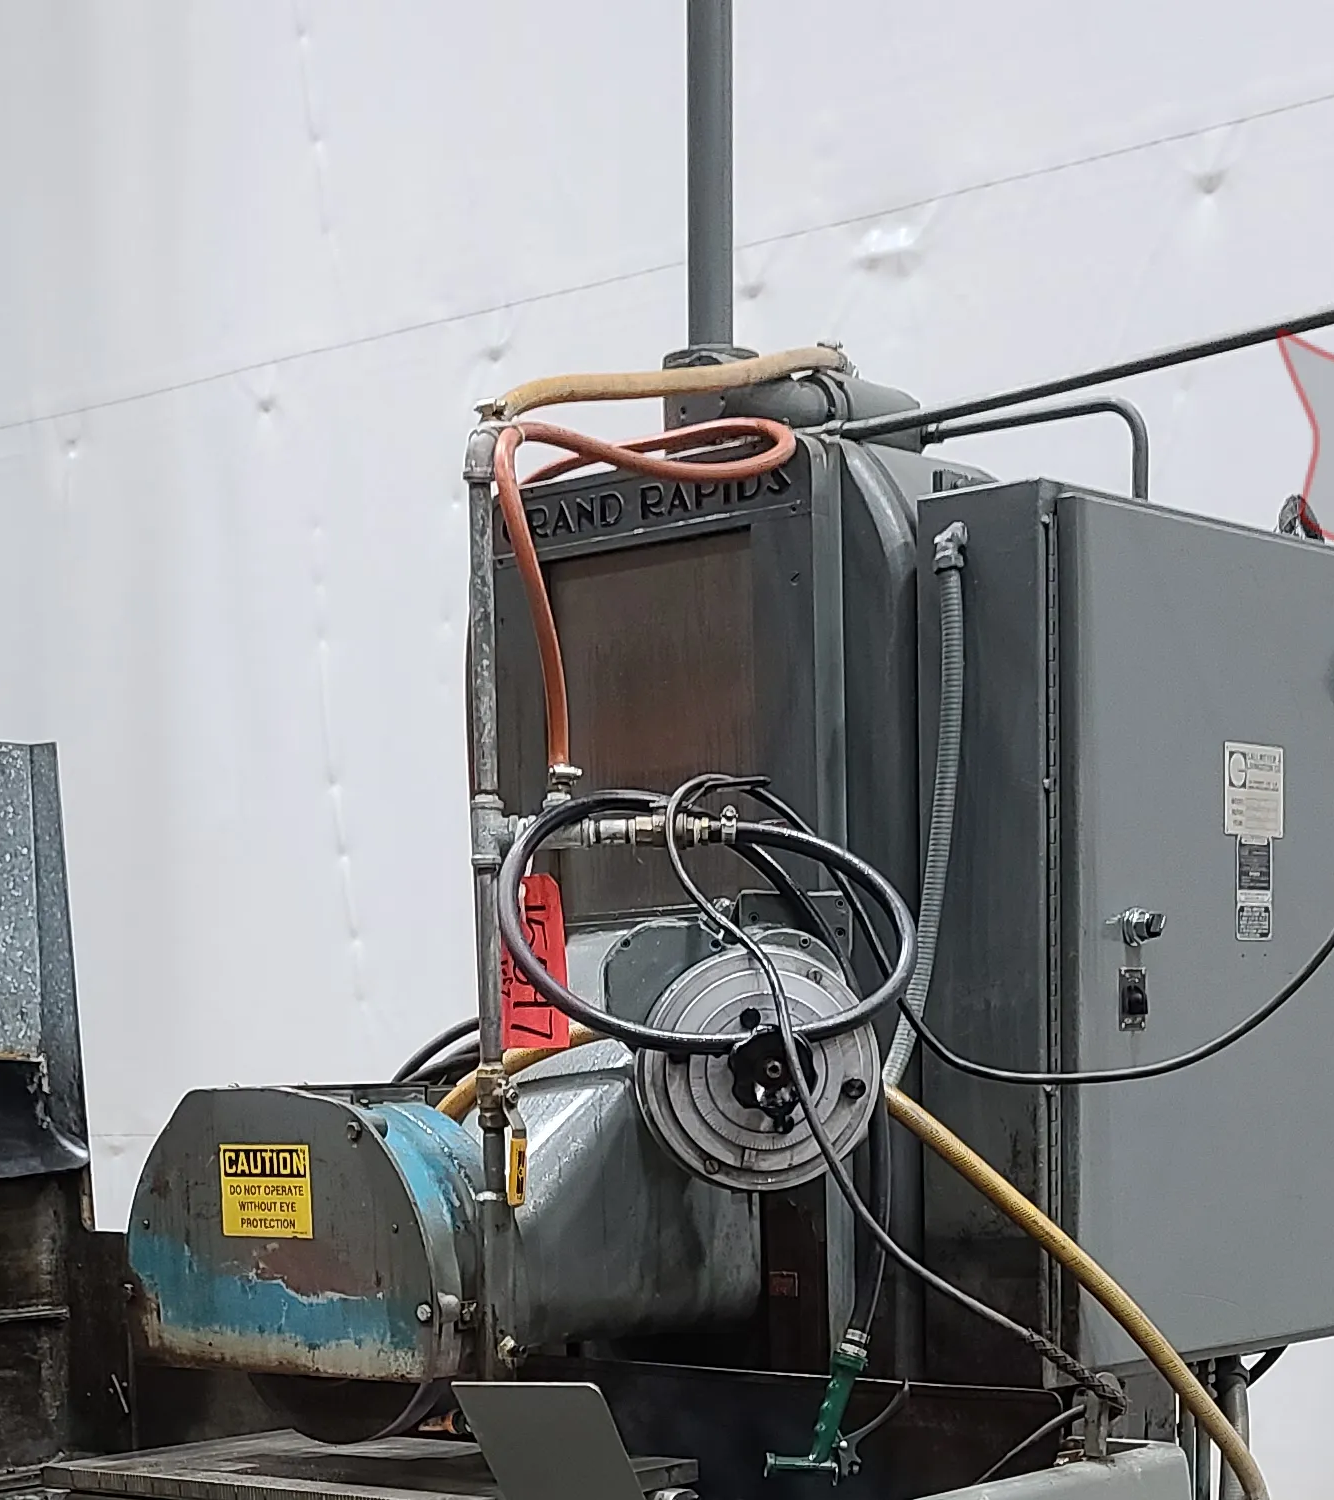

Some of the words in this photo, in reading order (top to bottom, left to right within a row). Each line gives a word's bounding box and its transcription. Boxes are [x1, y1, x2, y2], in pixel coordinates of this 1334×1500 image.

[502, 491, 625, 545] RAND
[224, 1151, 305, 1176] CAUTION
[229, 1185, 242, 1196] DO
[244, 1185, 262, 1196] NOT
[264, 1185, 304, 1197] OPERATE
[238, 1201, 277, 1212] WITHOUT
[279, 1202, 296, 1213] EYE
[240, 1218, 295, 1230] PROTECTION
